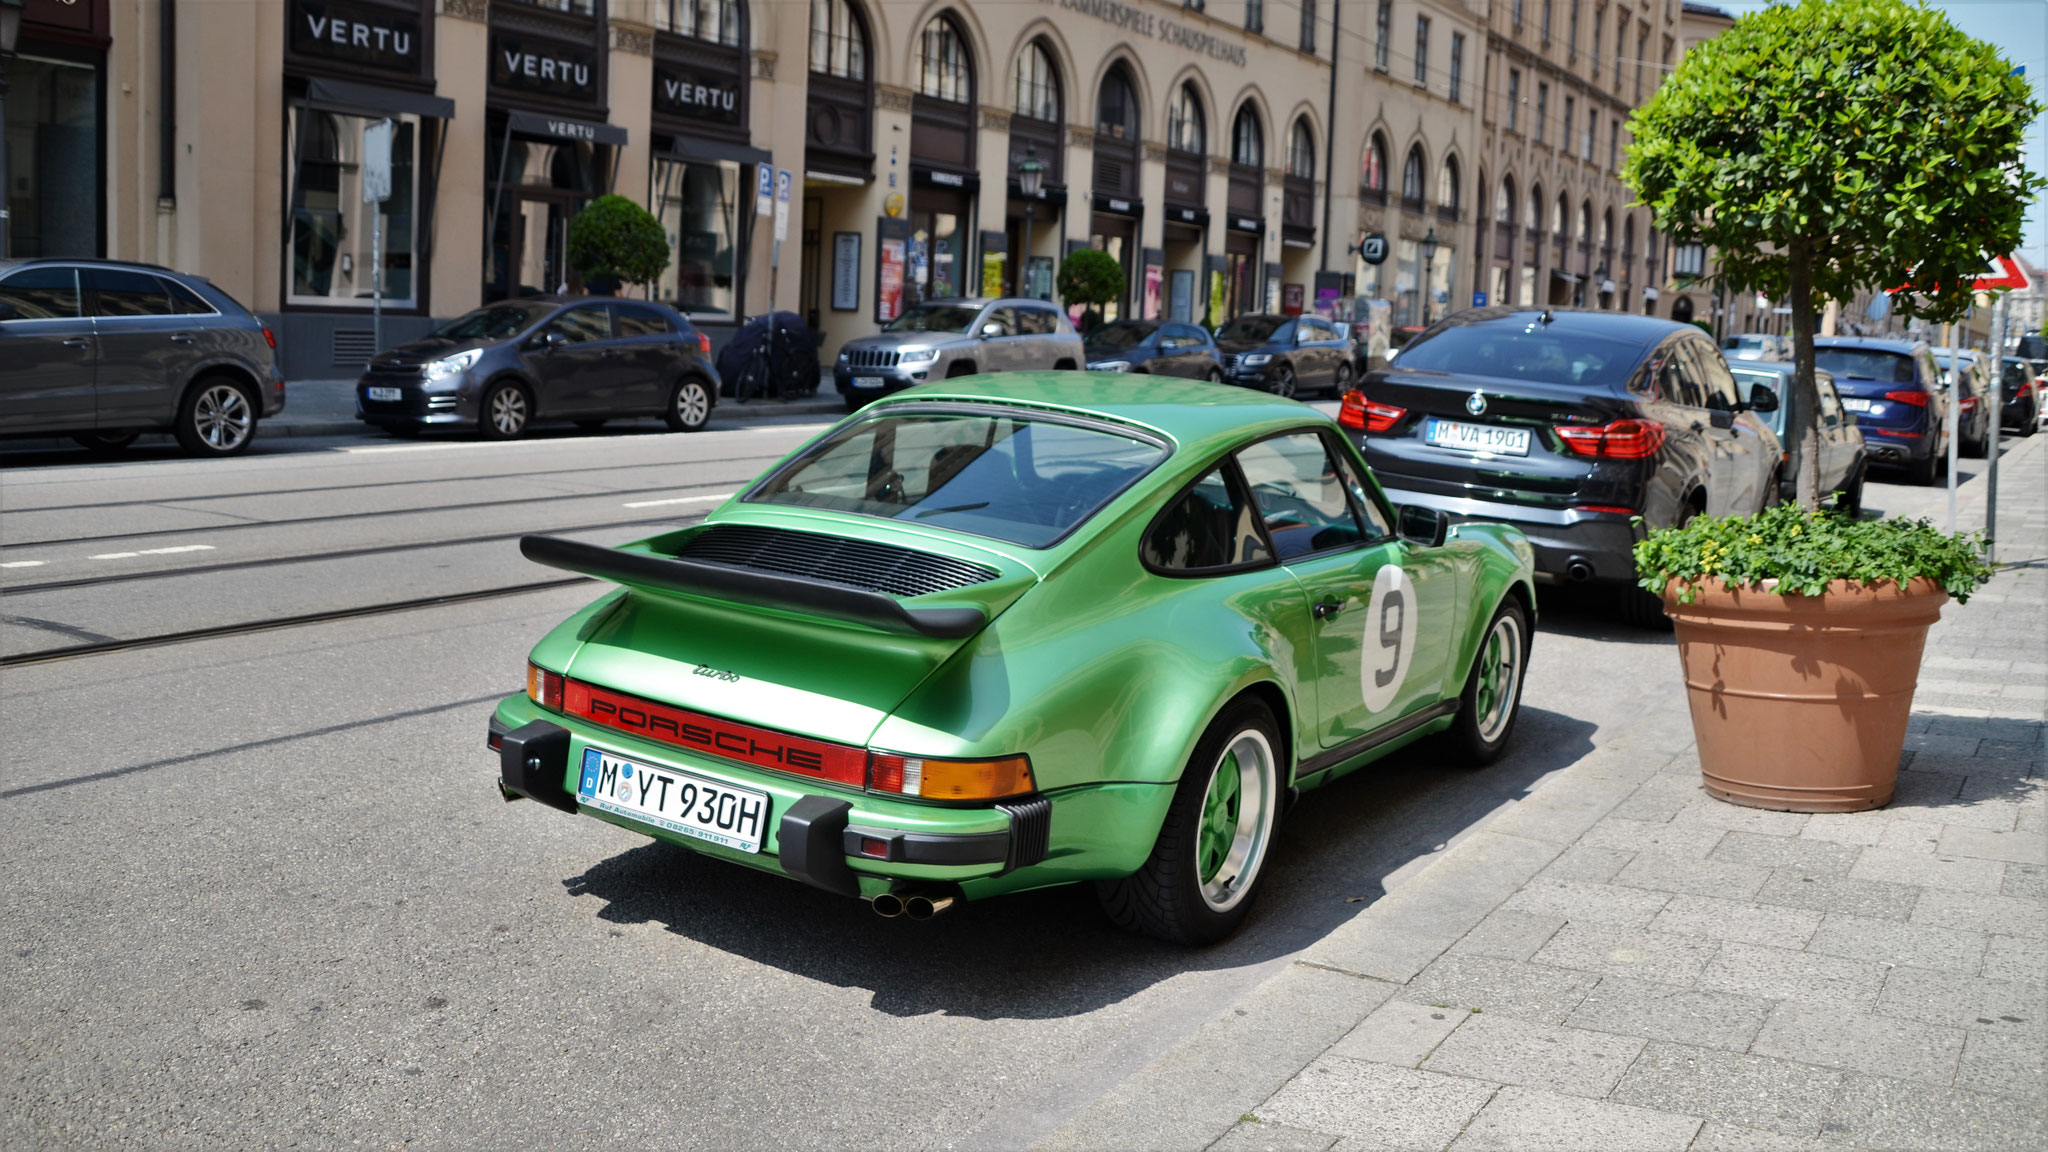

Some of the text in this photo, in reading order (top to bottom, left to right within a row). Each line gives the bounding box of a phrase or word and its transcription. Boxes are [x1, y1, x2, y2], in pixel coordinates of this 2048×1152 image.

[307, 13, 410, 55] VERTU
[1158, 18, 1248, 68] SCHAUSPIELHAUS
[504, 50, 589, 86] VERTU
[665, 79, 734, 111] VERTU
[548, 120, 595, 139] VERTU
[1438, 423, 1450, 438] M
[1460, 425, 1479, 443] VA
[1485, 428, 1525, 448] 1901
[1375, 589, 1405, 688] 9
[692, 664, 740, 682] turbo
[590, 698, 822, 771] PORSCHE
[586, 777, 593, 788] D
[598, 759, 761, 837] M YT 930H
[600, 802, 613, 811] Ruf
[614, 807, 655, 823] Automobile
